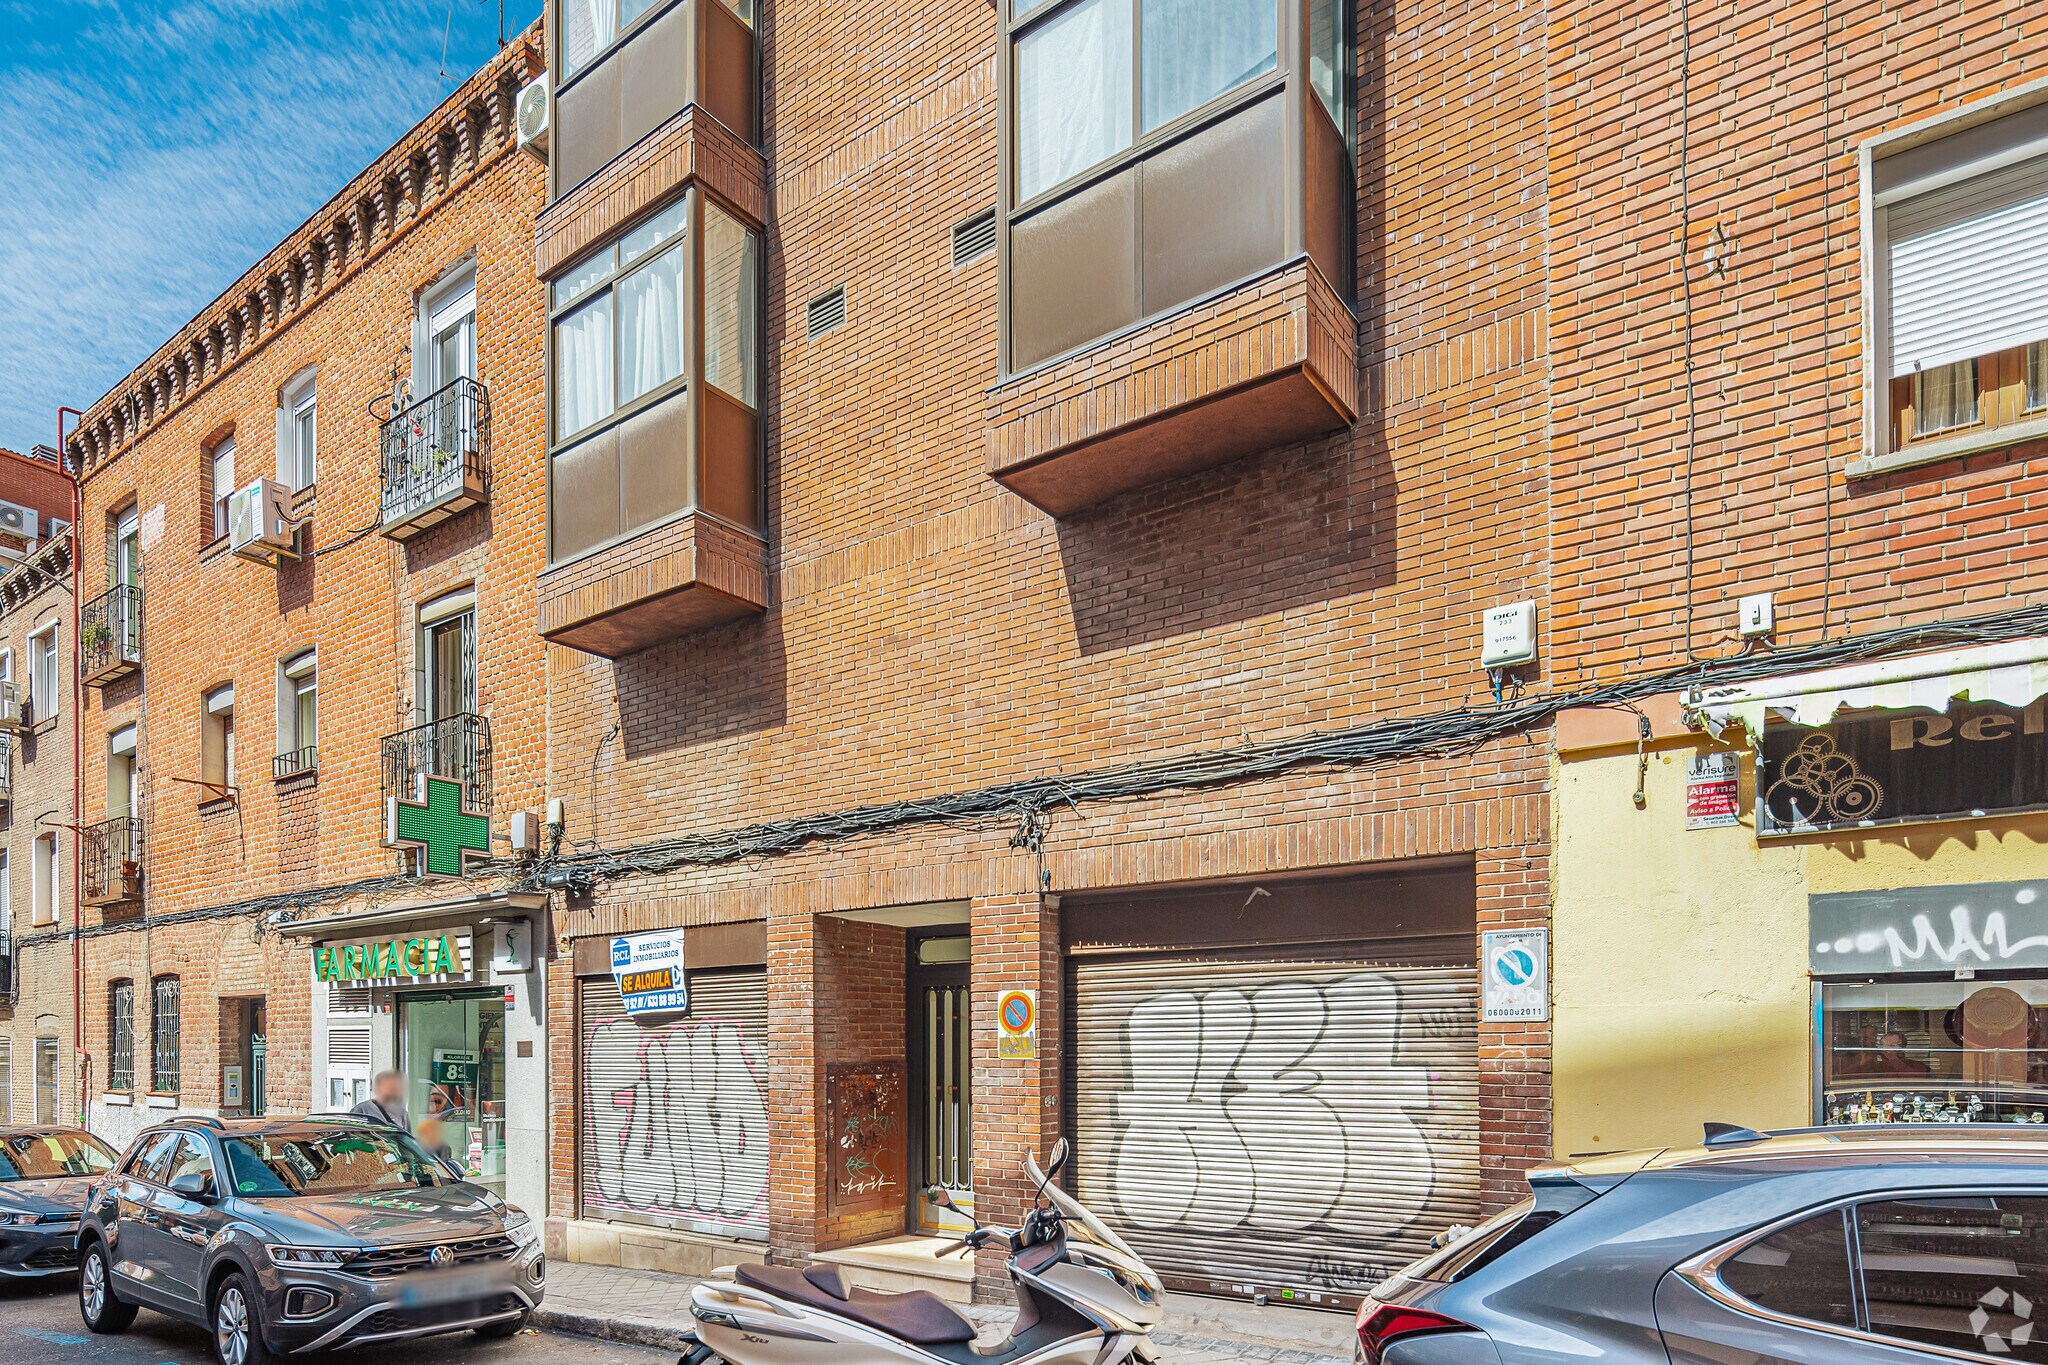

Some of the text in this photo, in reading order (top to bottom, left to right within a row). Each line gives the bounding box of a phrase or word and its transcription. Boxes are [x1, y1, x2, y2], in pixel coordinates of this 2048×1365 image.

[1493, 611, 1518, 620] DIGI
[1689, 765, 1736, 776] verisure
[1688, 785, 1737, 796] Alarma
[638, 940, 671, 952] SERVICIOS
[317, 934, 453, 982] FARMACIA
[613, 950, 631, 962] RCL
[633, 949, 679, 963] INMOBILIARIOS
[622, 975, 633, 992] SE
[634, 970, 671, 990] ALQUILA
